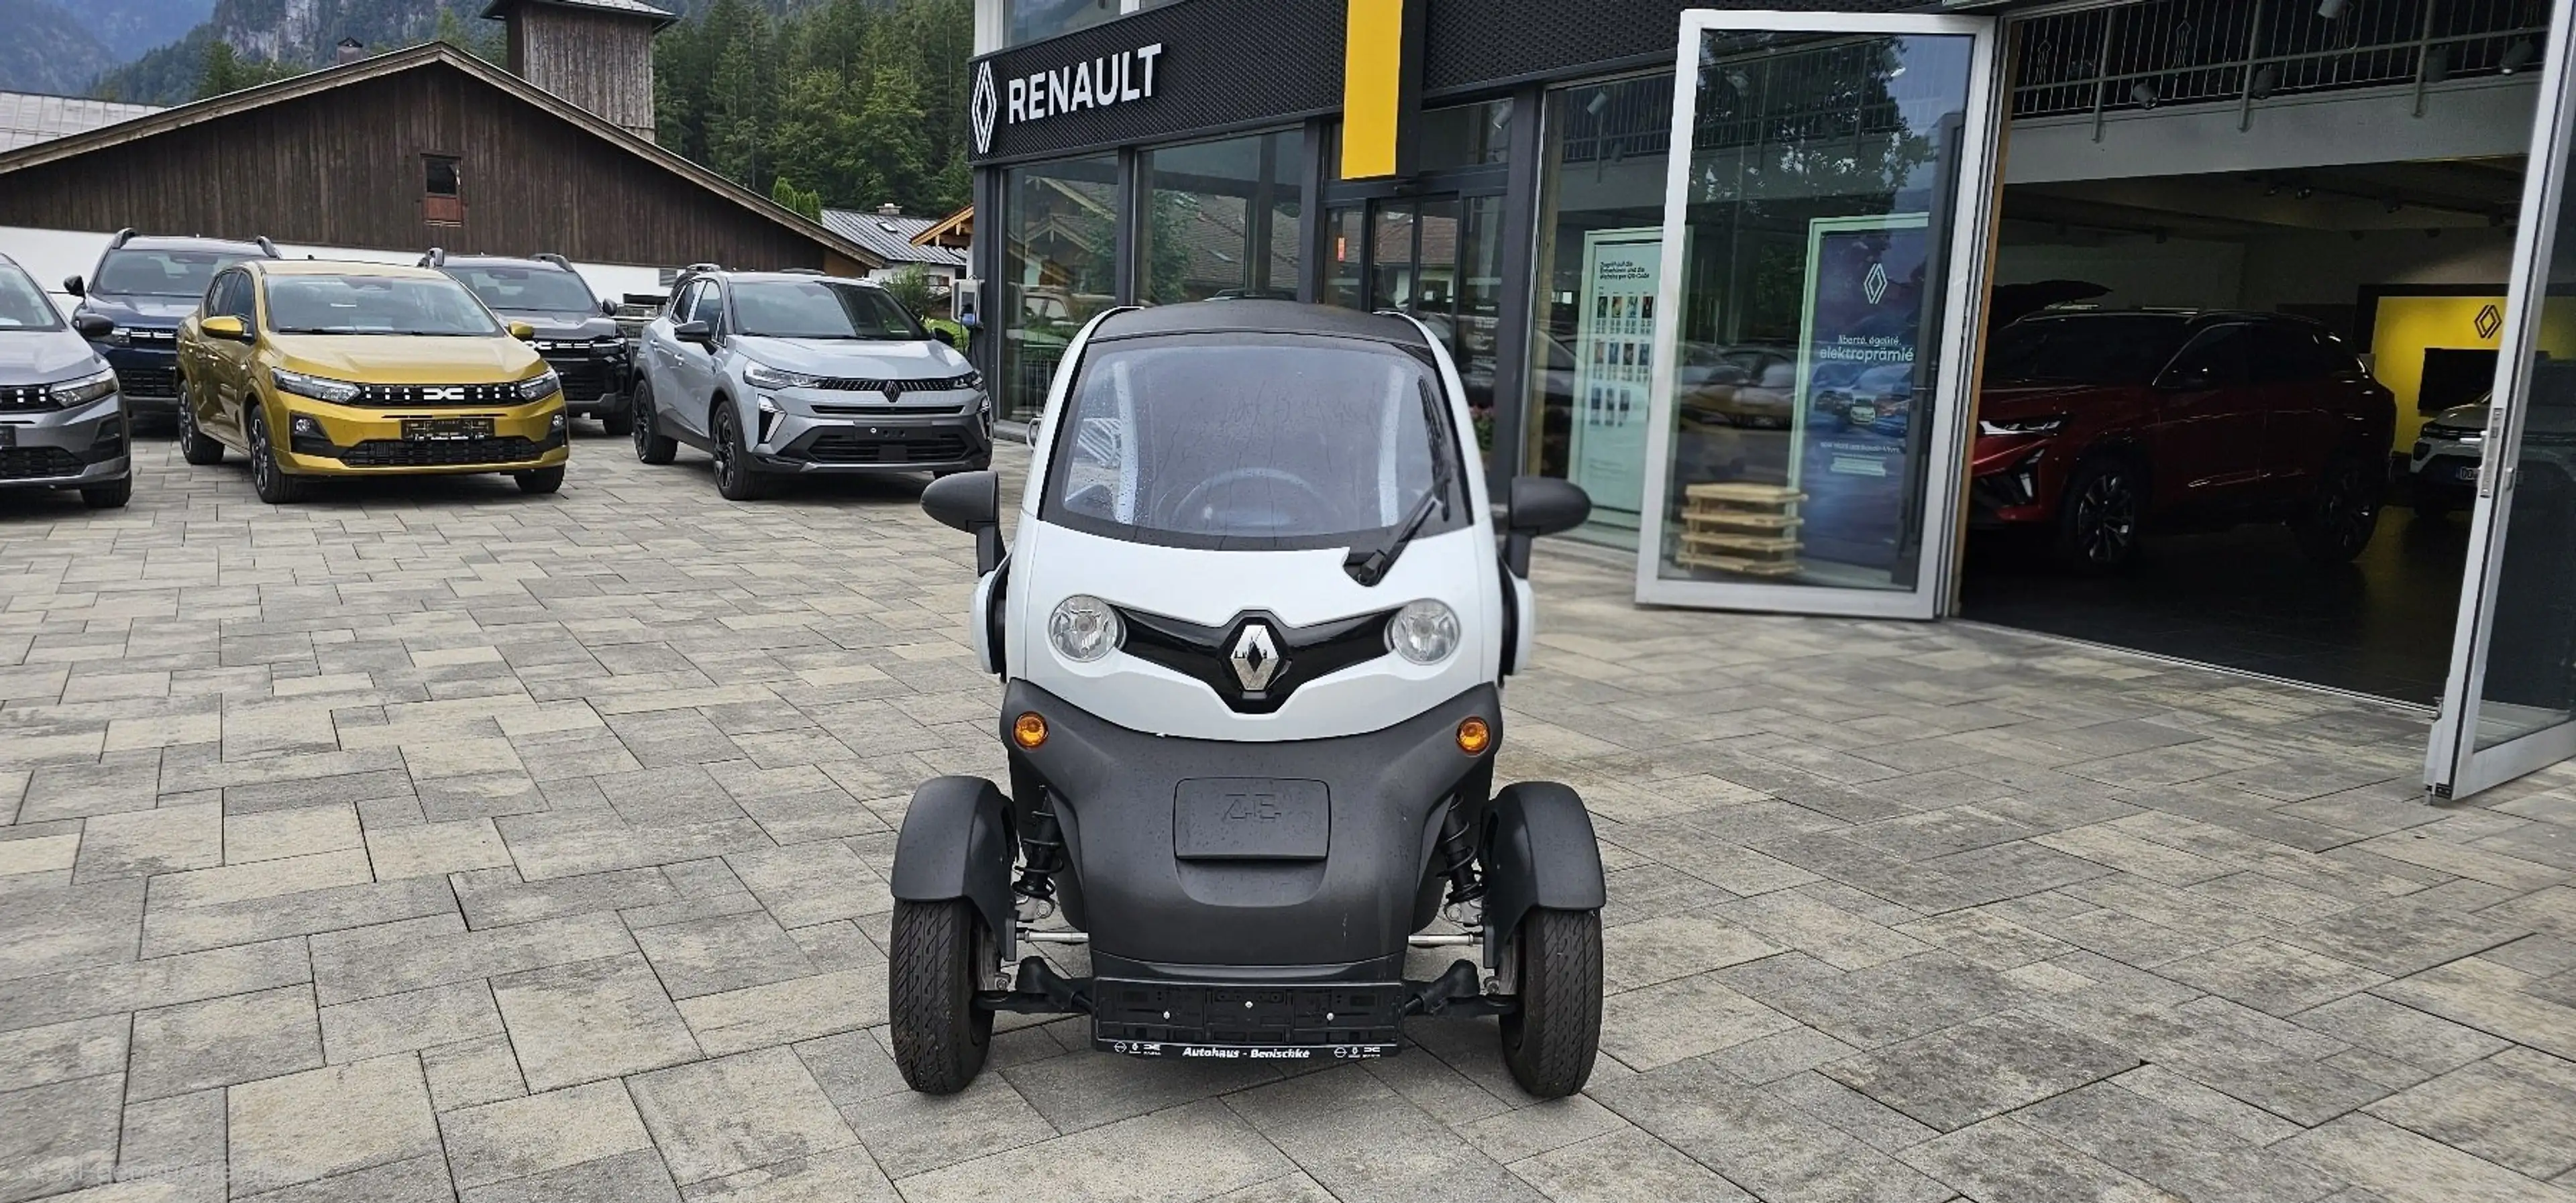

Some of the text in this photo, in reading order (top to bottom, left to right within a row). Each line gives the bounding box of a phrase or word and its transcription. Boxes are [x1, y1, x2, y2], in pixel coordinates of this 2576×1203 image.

[1008, 43, 1163, 124] RENAULT
[1820, 345, 1914, 363] elektroprämié
[1182, 1047, 1240, 1058] Autohaus
[1250, 1048, 1310, 1058] Benischke
